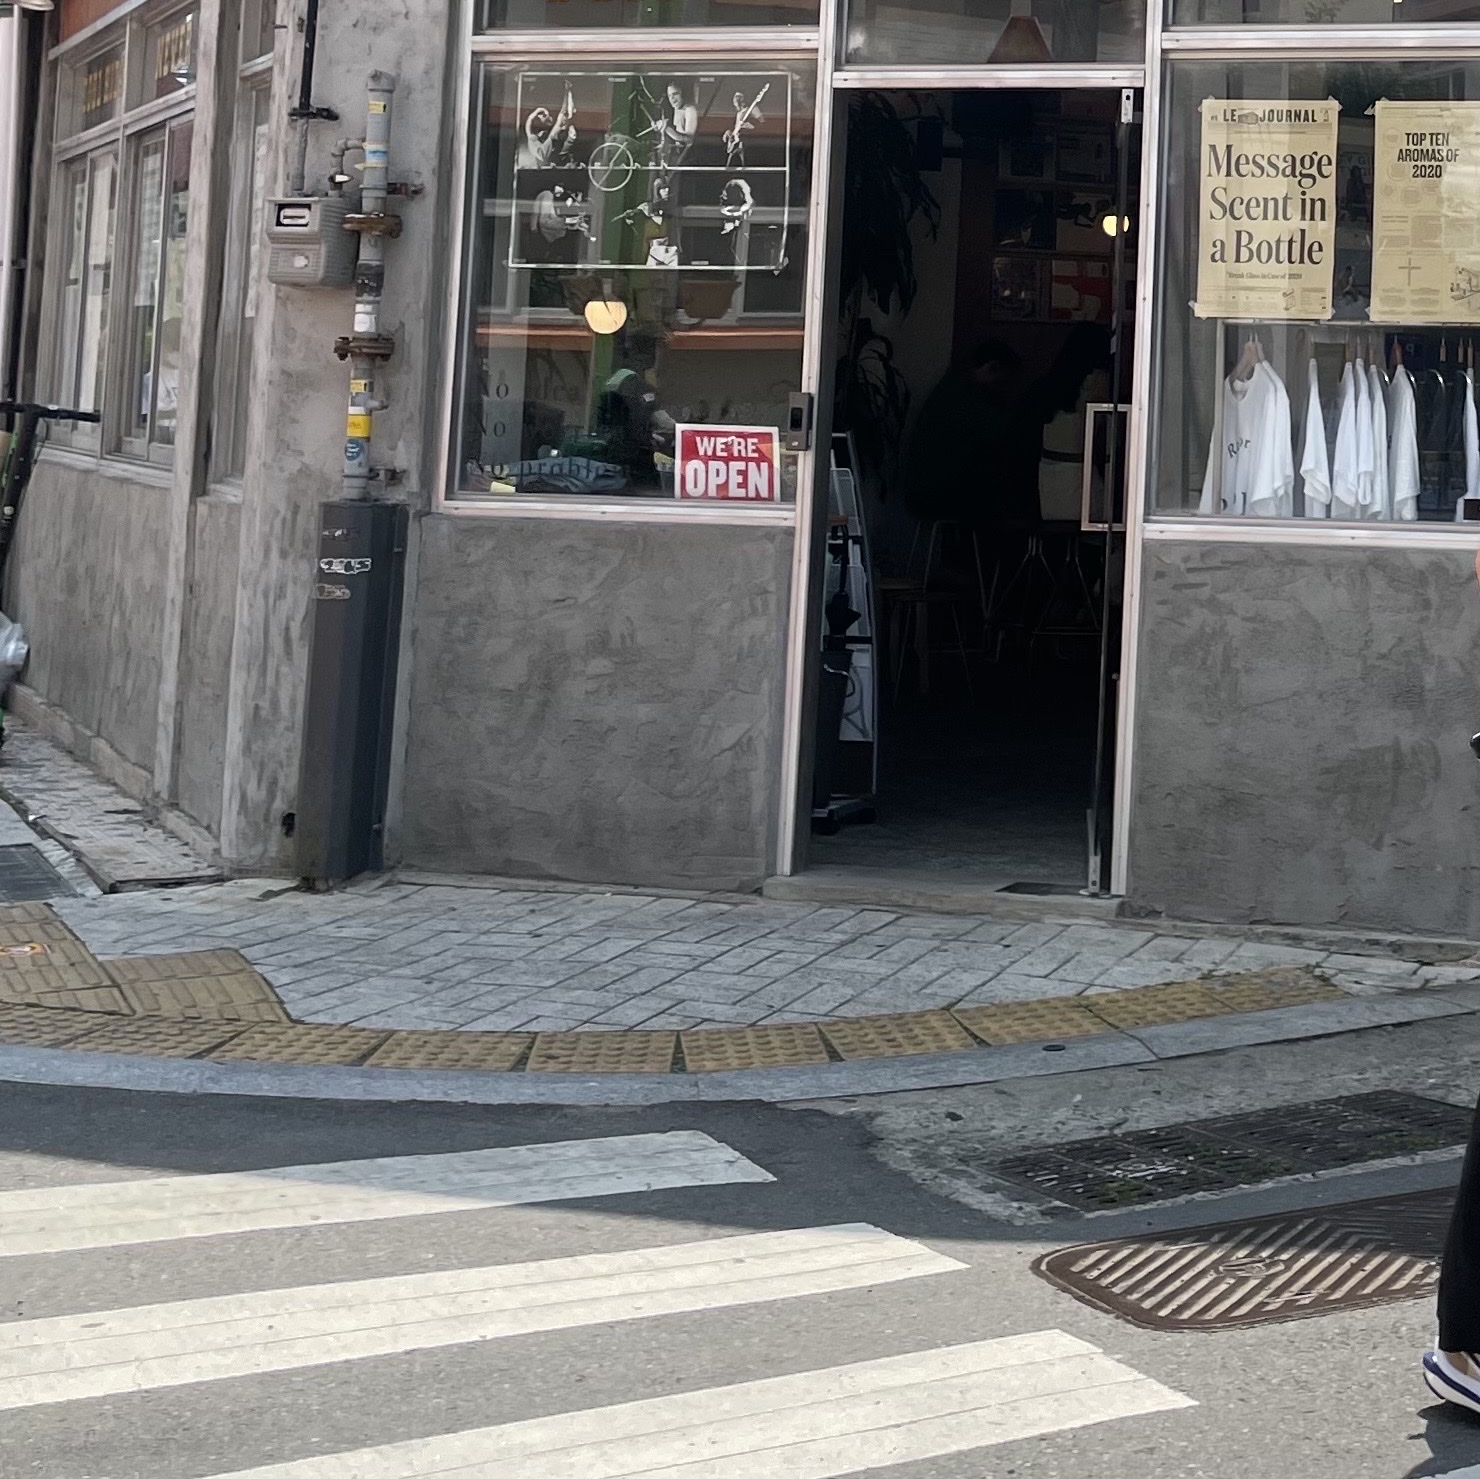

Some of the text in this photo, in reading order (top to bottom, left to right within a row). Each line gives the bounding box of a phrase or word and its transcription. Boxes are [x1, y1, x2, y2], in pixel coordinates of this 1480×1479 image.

[1222, 108, 1237, 123] LE
[1259, 108, 1318, 123] JOURNAL
[1405, 132, 1450, 147] TOP TEN
[1207, 144, 1333, 189] Message
[1397, 148, 1460, 163] AROMAS OF
[1411, 164, 1443, 179] 2020
[1208, 186, 1327, 222] Scent in
[1210, 228, 1324, 266] a Bottle
[685, 459, 769, 499] OPEN
